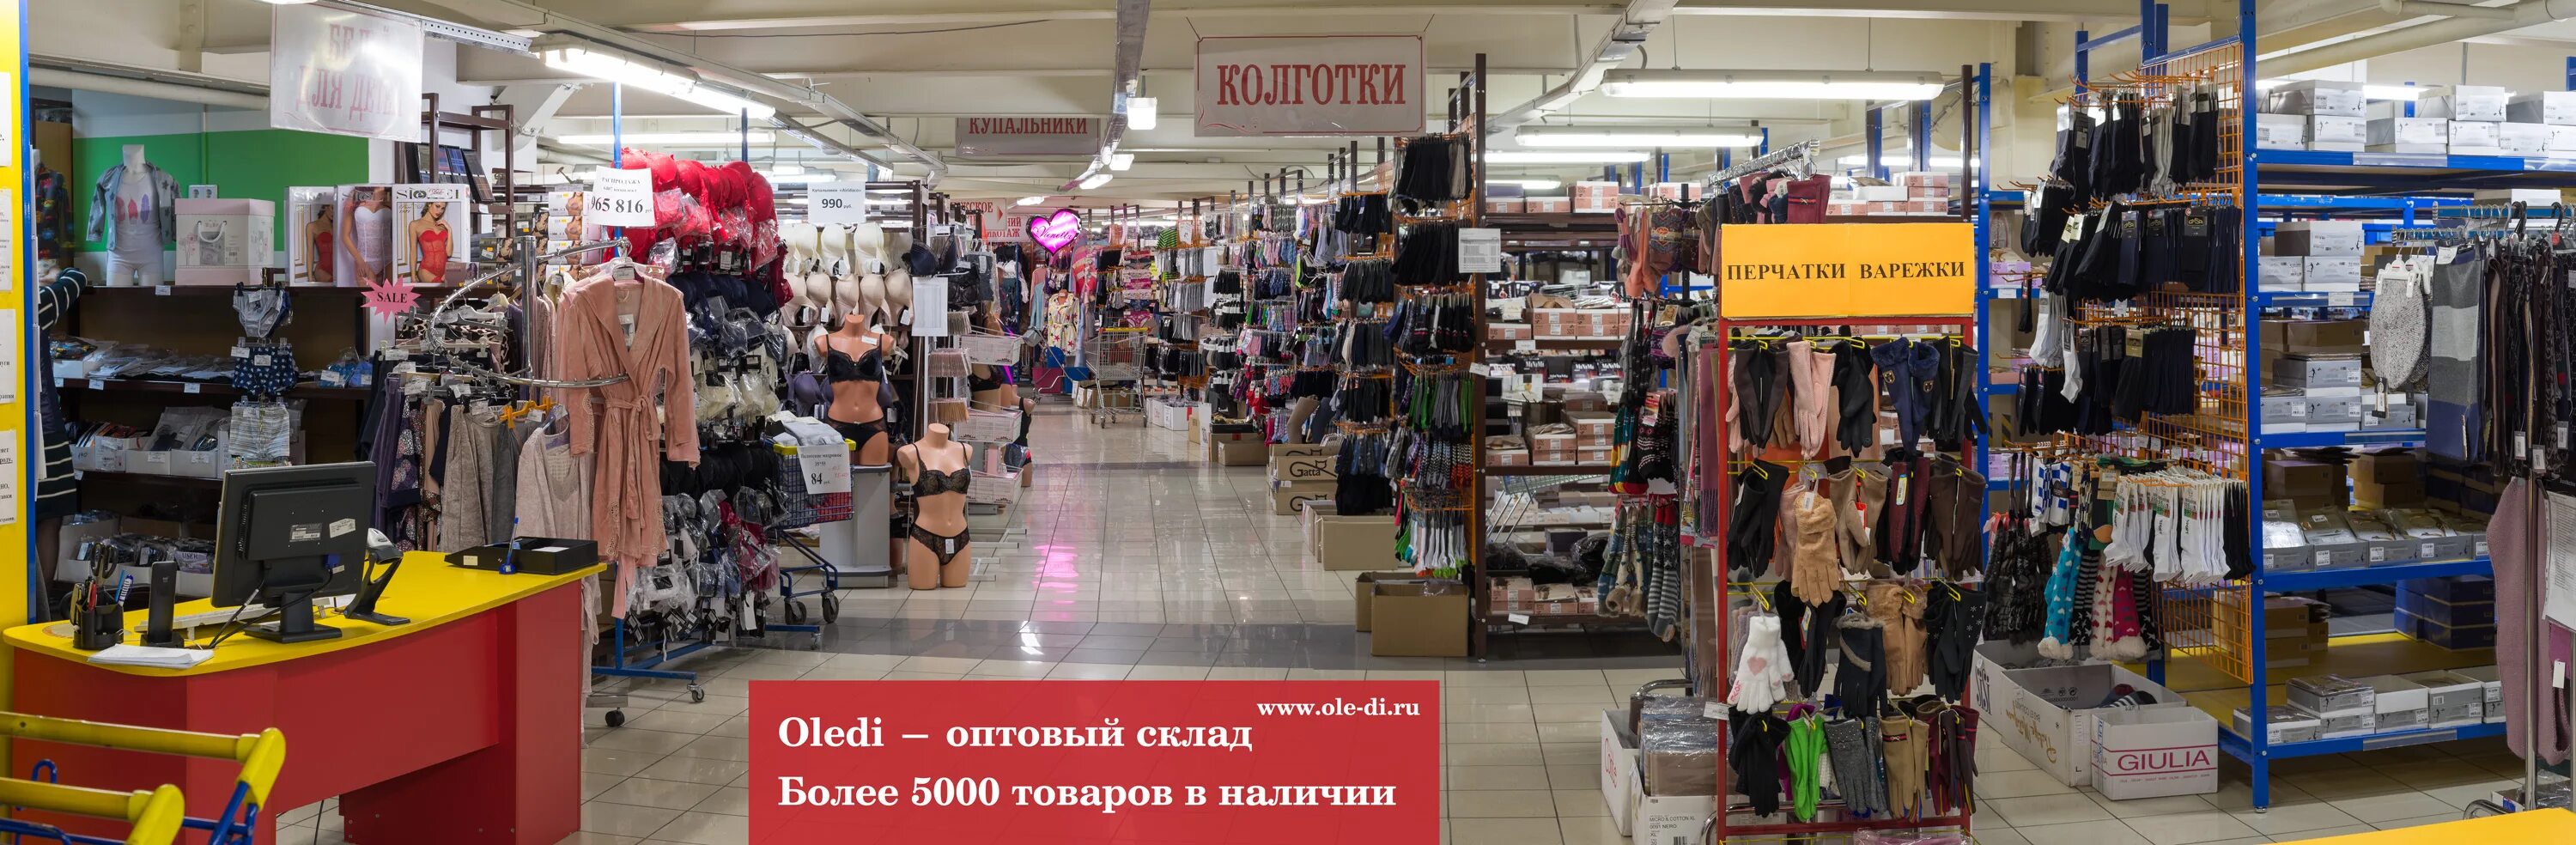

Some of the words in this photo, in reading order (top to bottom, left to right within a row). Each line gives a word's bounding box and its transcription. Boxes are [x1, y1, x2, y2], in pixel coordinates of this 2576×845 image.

[1217, 64, 1406, 106] КОЛГОТКИ
[969, 118, 1087, 134] КУПАЛЬНИКИ
[616, 198, 643, 214] 816
[822, 198, 842, 209] 990
[1727, 264, 1846, 280] ПЕРЧАТКИ
[1860, 261, 1965, 279] ВАРЕЖКИ
[377, 292, 408, 303] SALE
[1290, 461, 1321, 477] Gatta
[811, 472, 822, 484] 84
[2117, 750, 2210, 771] GIULIA
